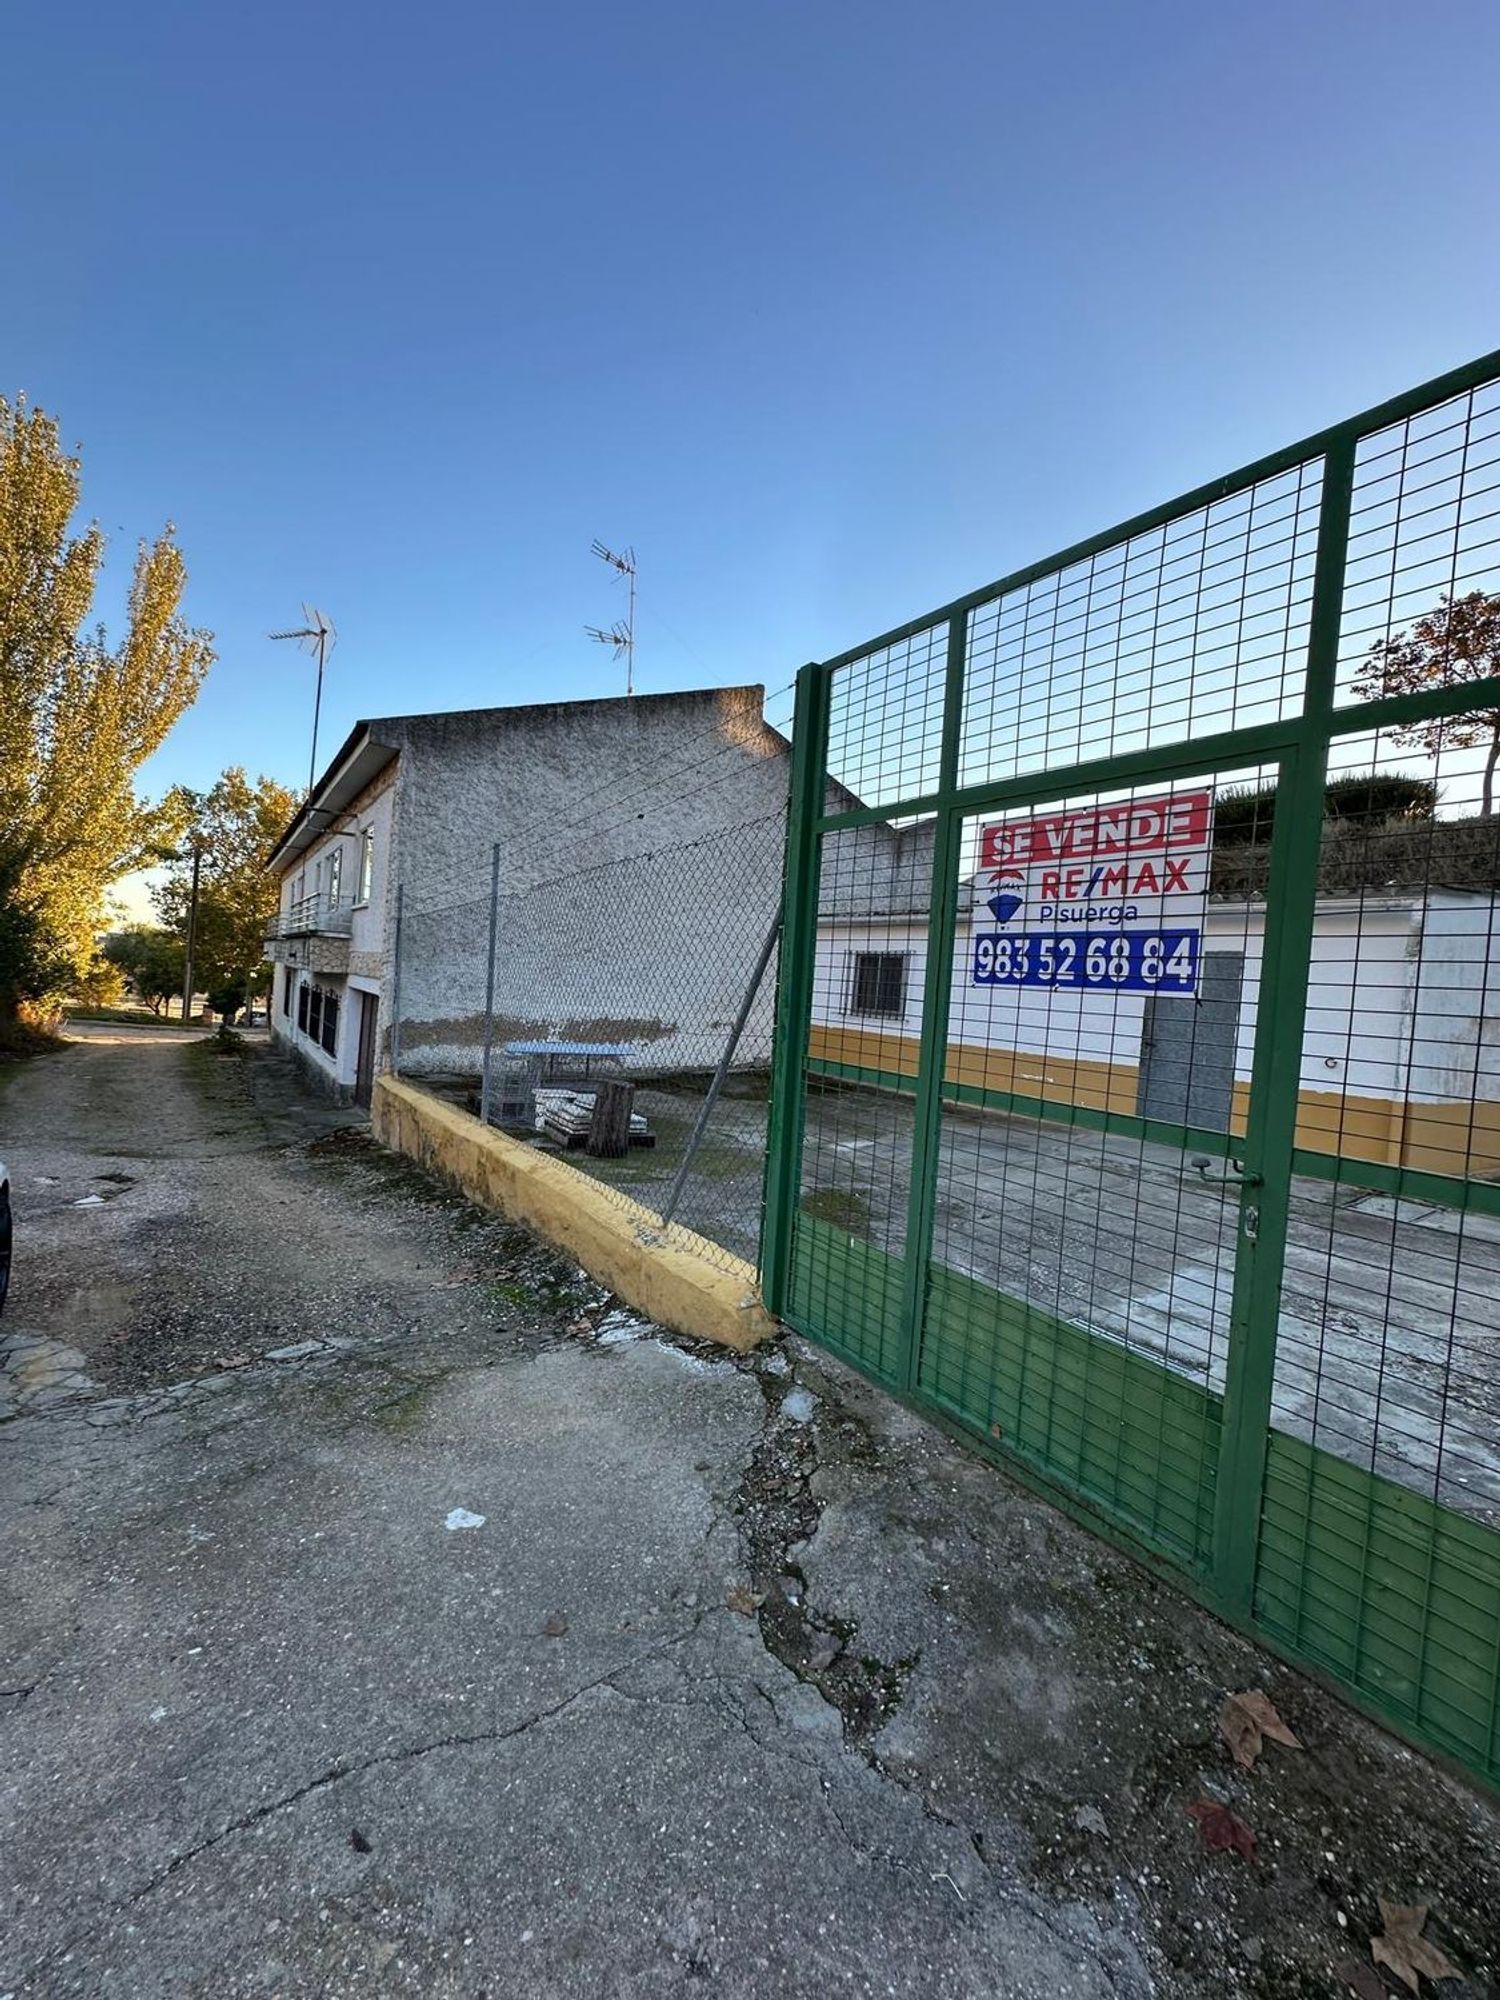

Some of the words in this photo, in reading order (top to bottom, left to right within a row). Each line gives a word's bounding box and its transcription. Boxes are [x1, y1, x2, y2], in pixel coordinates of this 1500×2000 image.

[993, 828, 1031, 861] SE
[1046, 803, 1192, 854] VENDE
[1042, 859, 1190, 899] RE/MAX
[1040, 905, 1137, 924] Pisuerga
[978, 939, 1030, 978] 983
[1038, 938, 1075, 980] 52
[1085, 938, 1131, 982] 68
[1140, 937, 1193, 985] 84
